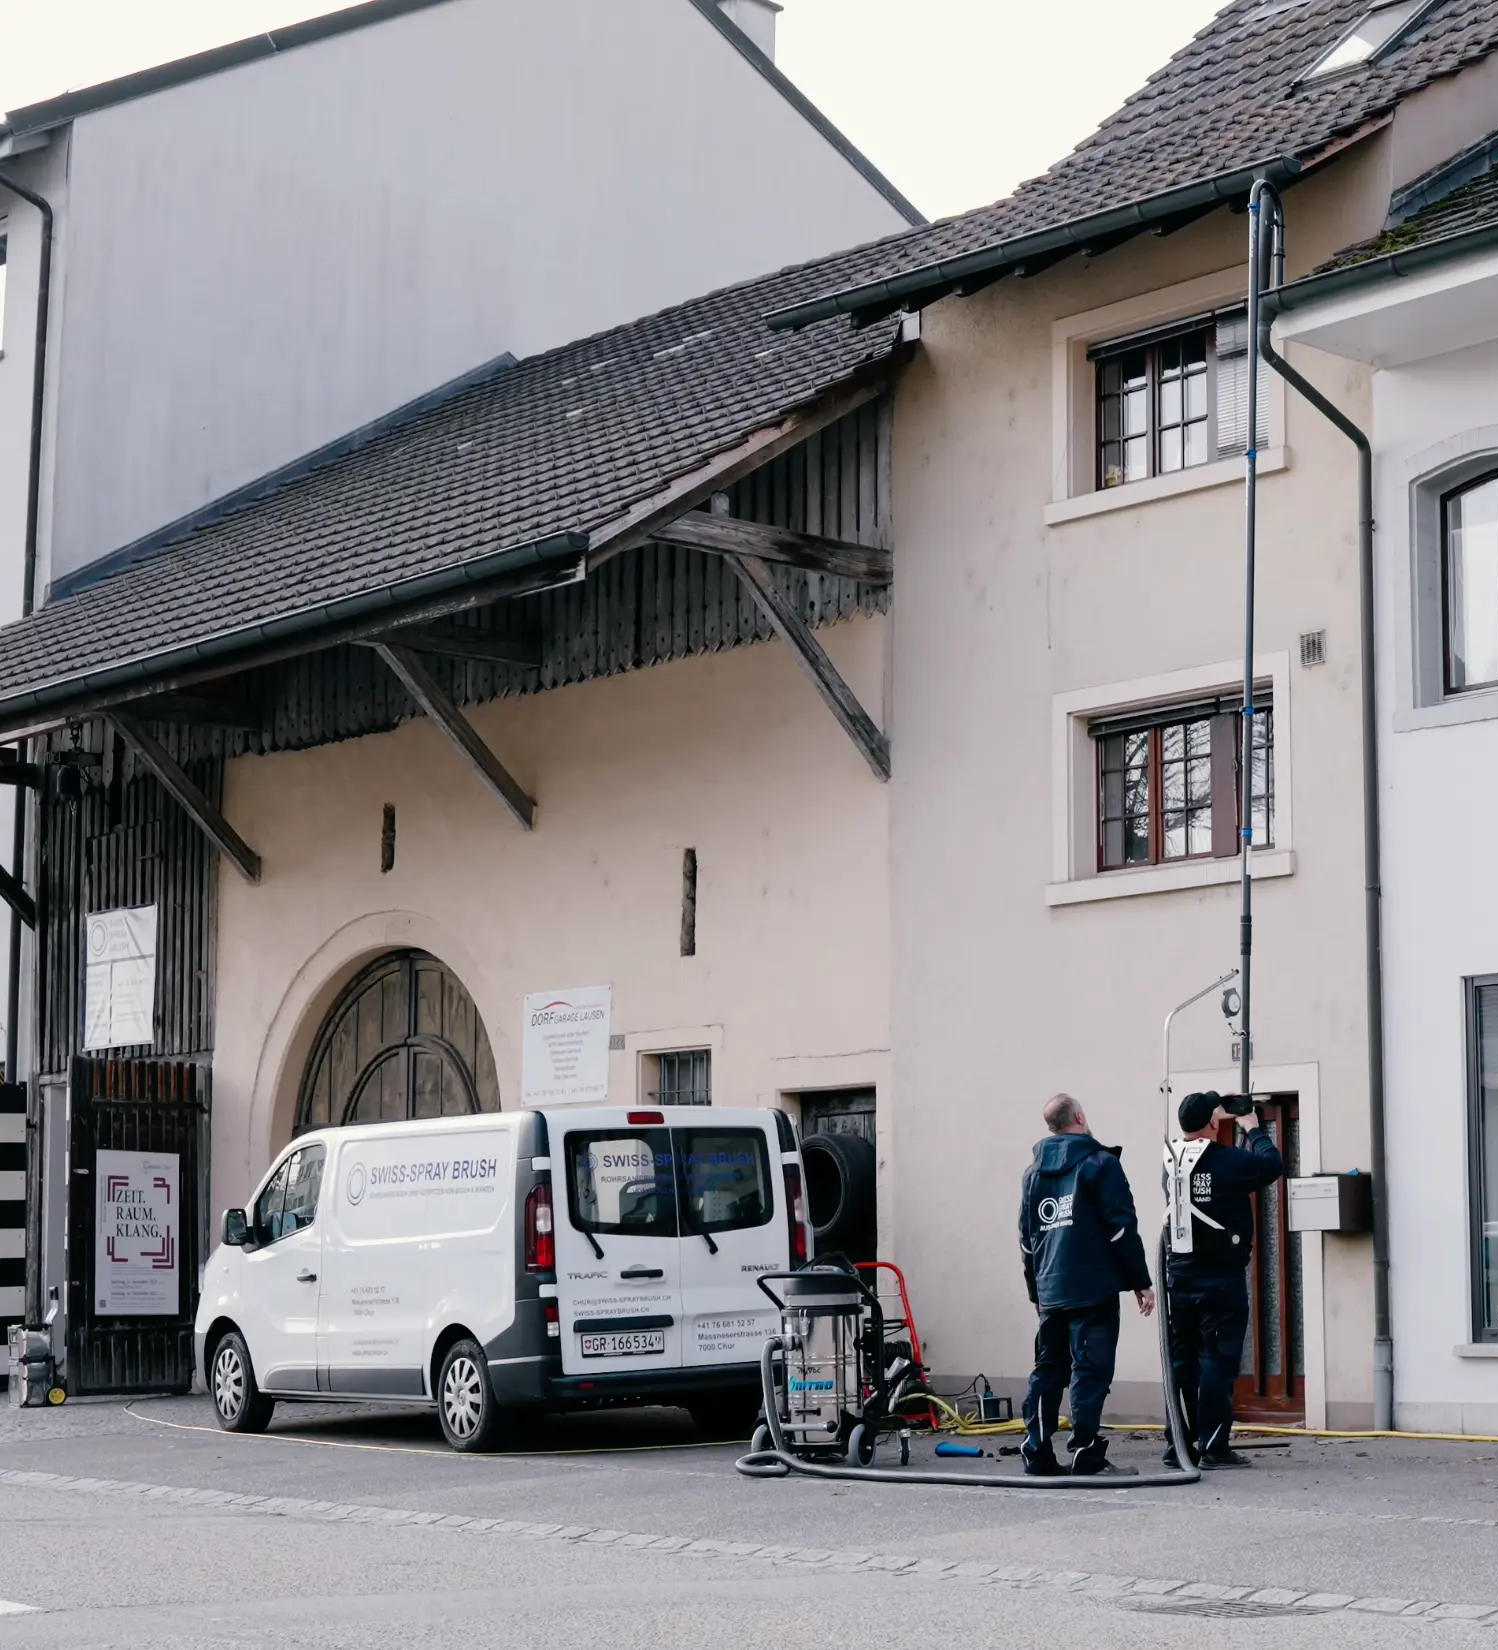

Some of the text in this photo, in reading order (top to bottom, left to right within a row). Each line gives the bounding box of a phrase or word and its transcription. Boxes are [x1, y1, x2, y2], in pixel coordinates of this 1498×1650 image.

[580, 1010, 605, 1021] LAUSEN
[370, 1158, 497, 1184] SWISS-SPRAY BRUSH
[116, 1189, 146, 1204] ZEIT.
[116, 1206, 156, 1221] RAUM.
[116, 1223, 162, 1238] KLANG.
[741, 1263, 779, 1272] RENAULT
[567, 1271, 608, 1280] TRAFIC
[697, 1321, 710, 1329] +41
[698, 1342, 735, 1352] 7000 Chur
